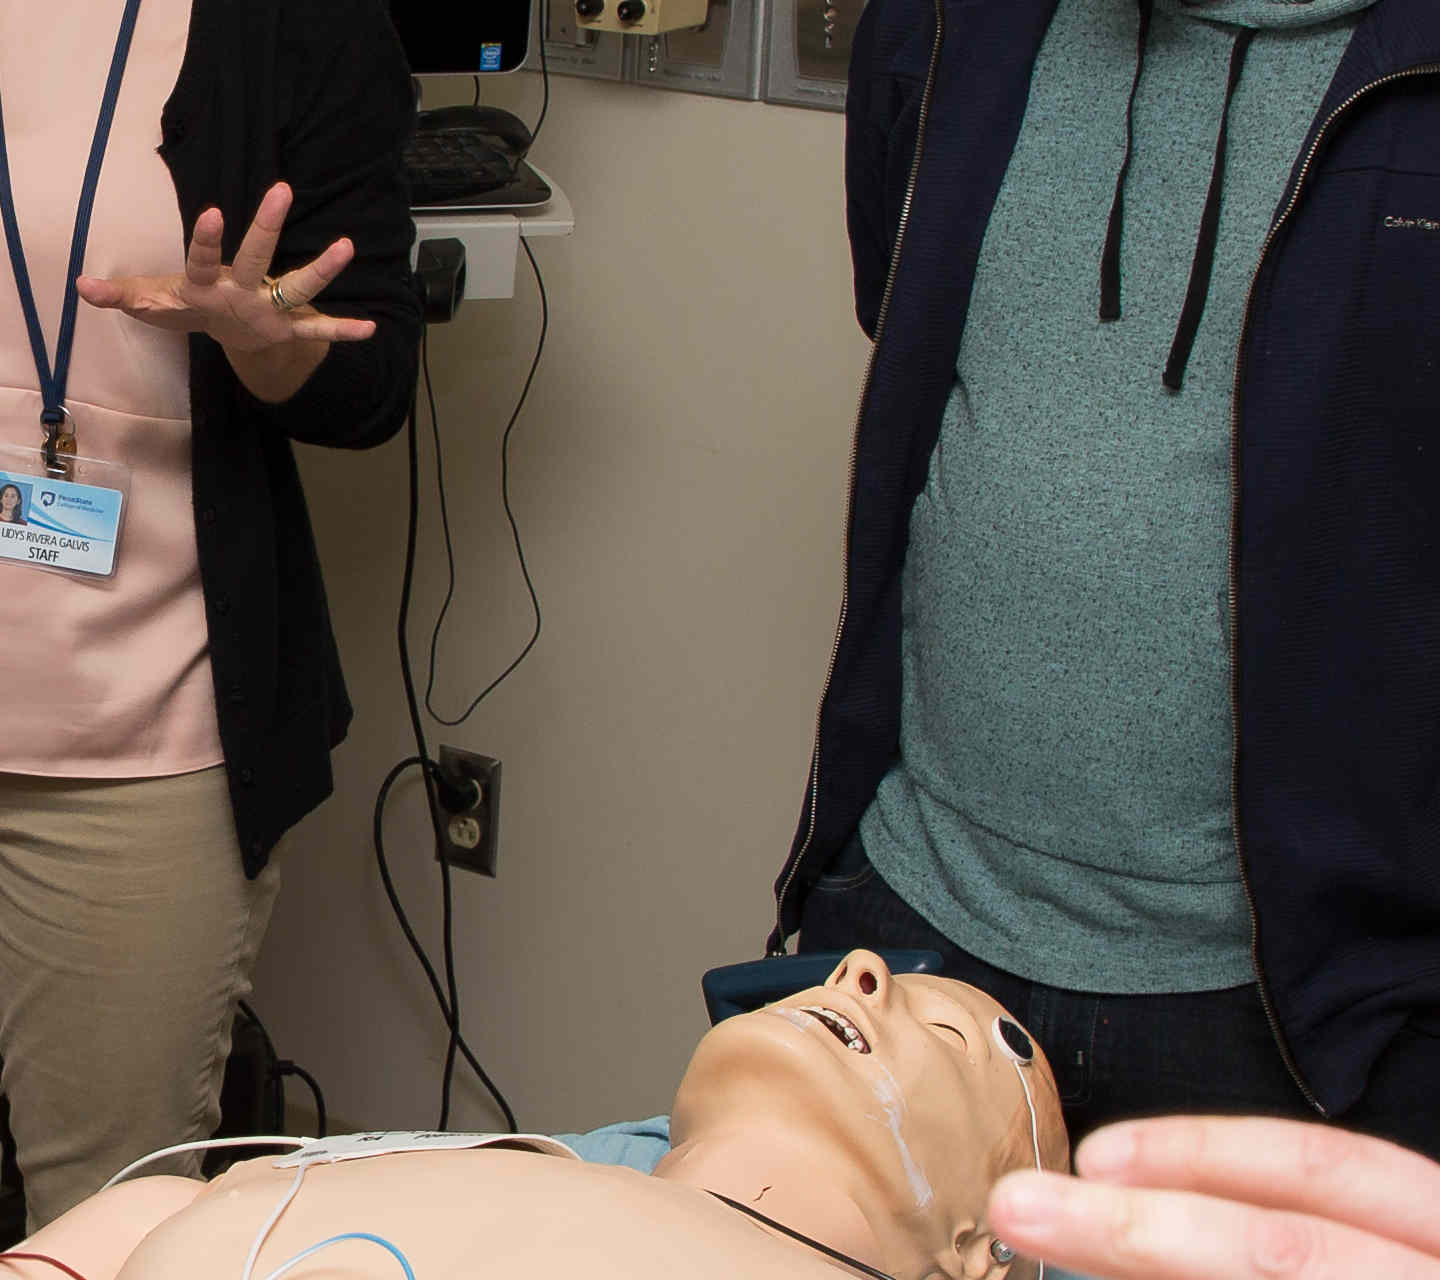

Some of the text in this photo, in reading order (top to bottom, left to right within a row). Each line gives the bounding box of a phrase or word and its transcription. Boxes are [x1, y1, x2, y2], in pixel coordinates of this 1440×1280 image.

[26, 531, 57, 546] RIVERA
[59, 538, 90, 552] GALVIS
[28, 547, 60, 563] STAFF
